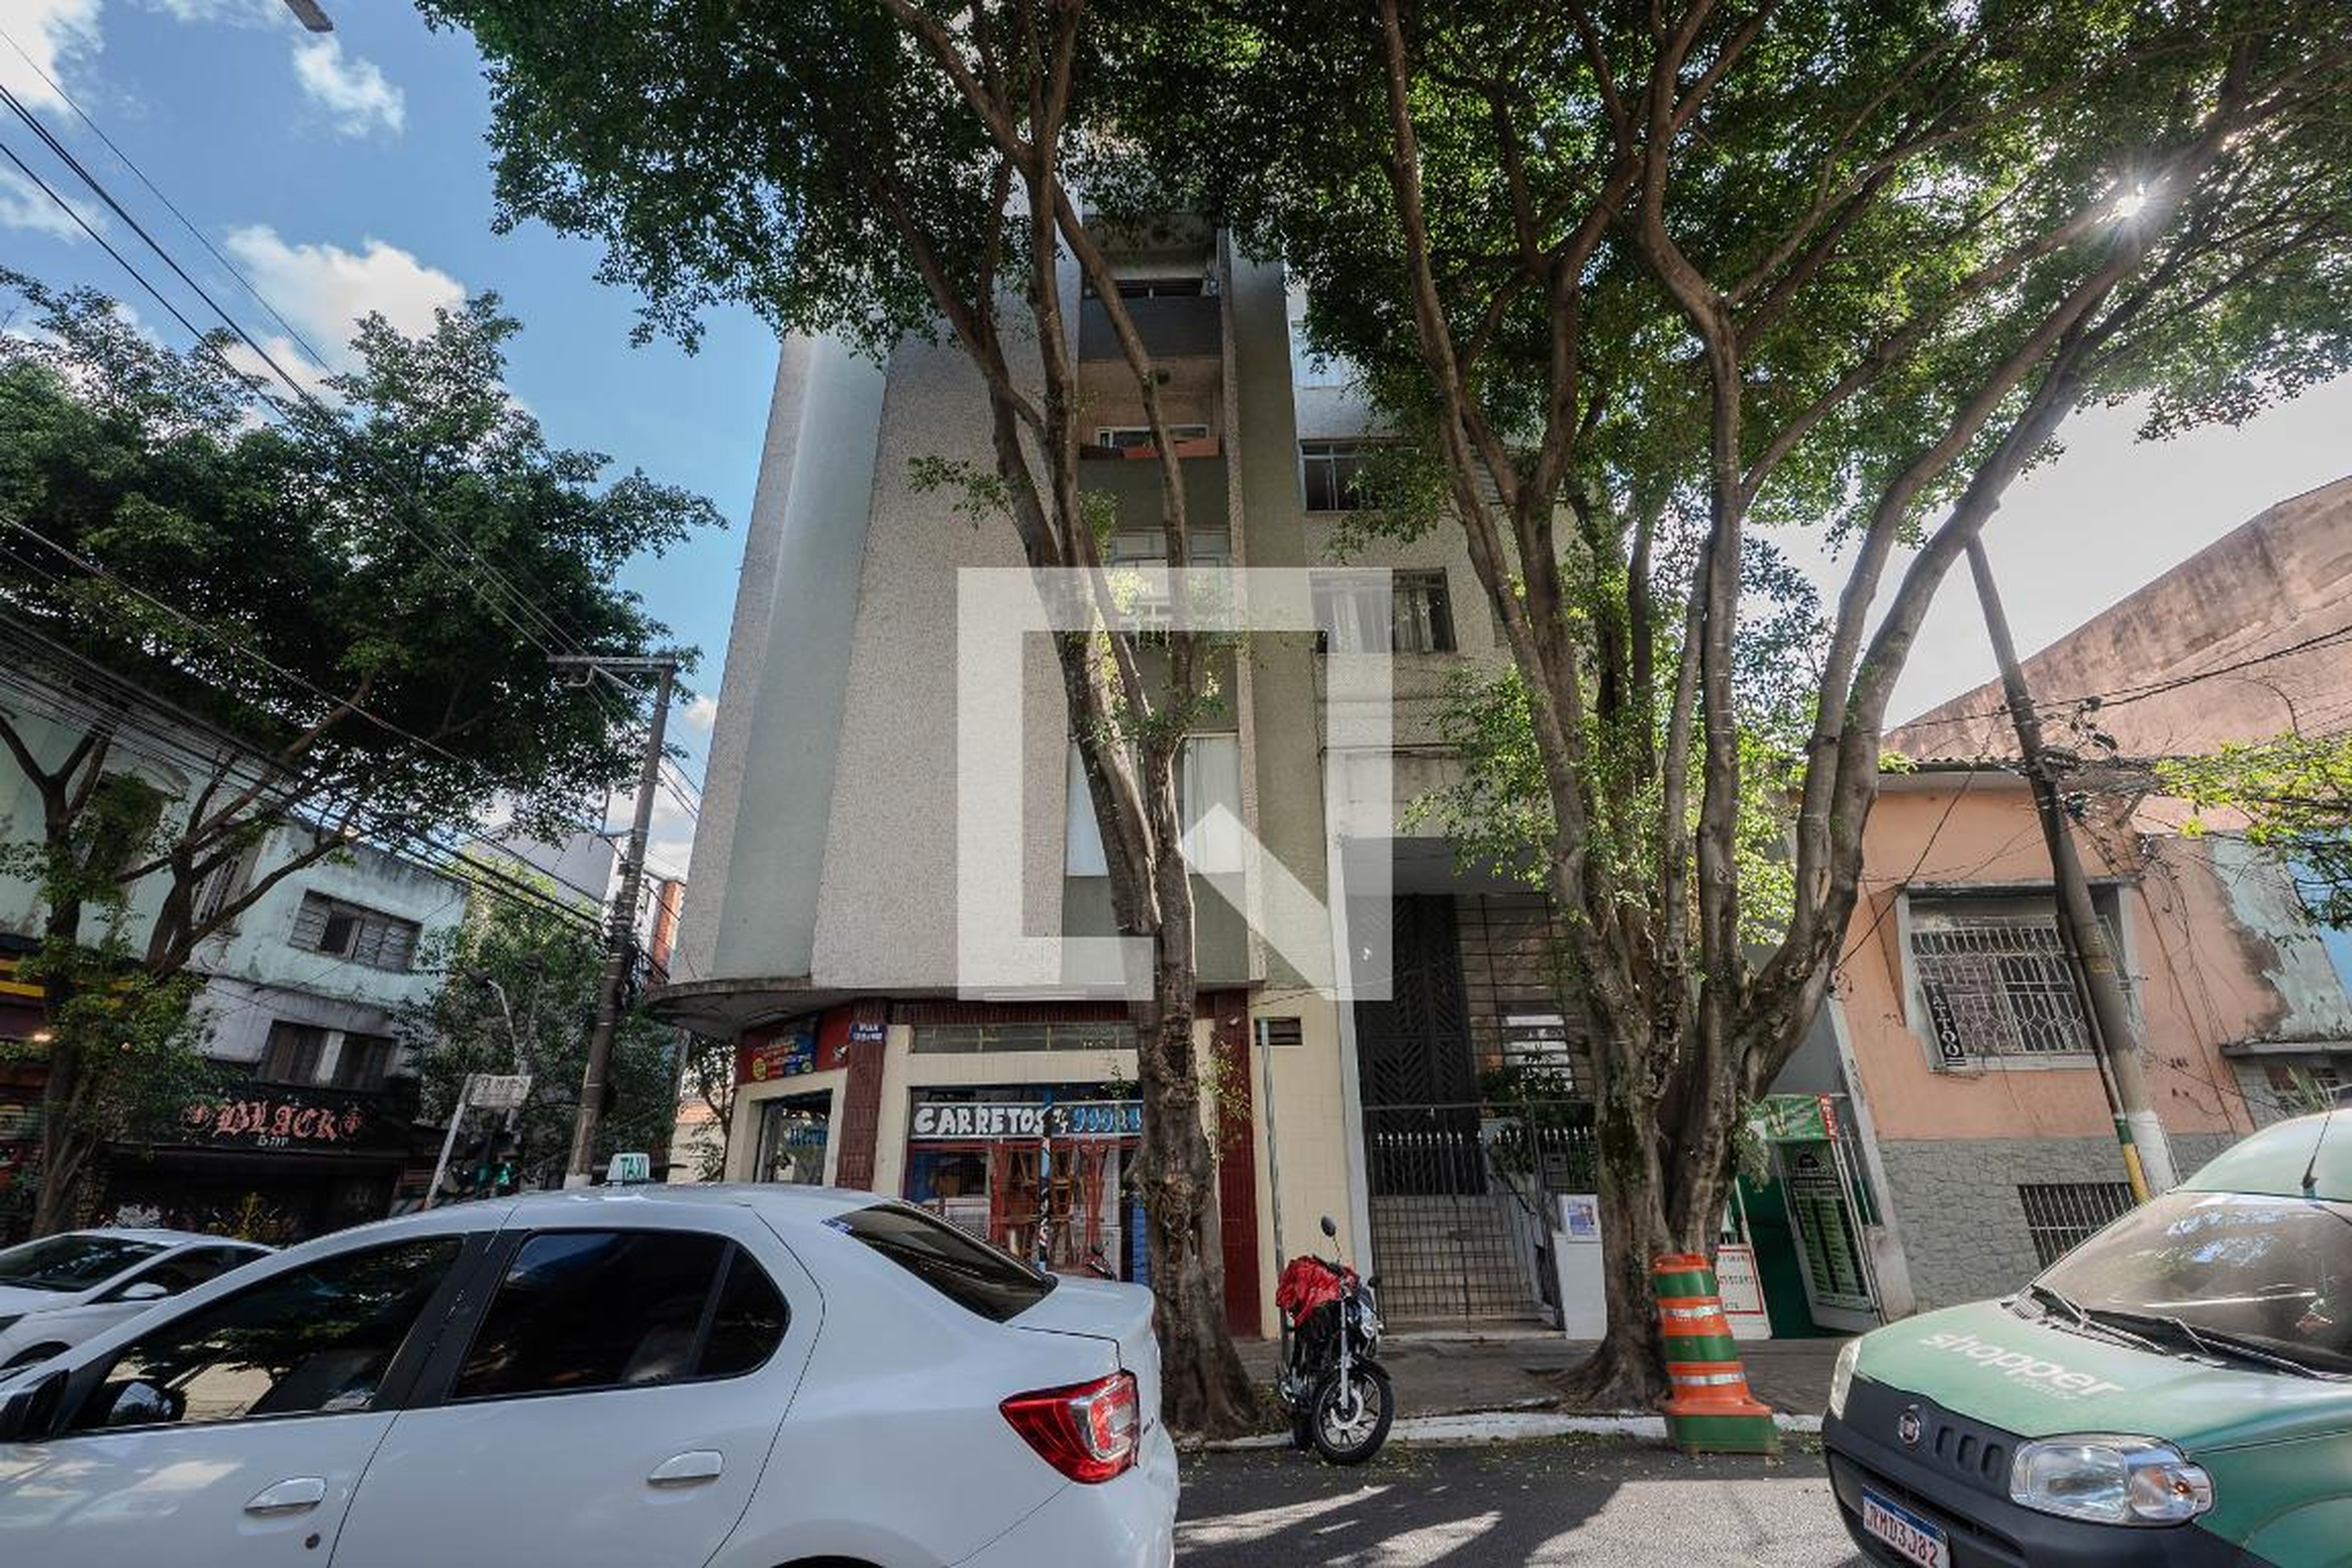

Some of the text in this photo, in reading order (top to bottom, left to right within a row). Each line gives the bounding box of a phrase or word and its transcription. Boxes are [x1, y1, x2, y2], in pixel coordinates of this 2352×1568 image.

[1926, 981, 1959, 1056] TATTOO
[212, 1100, 337, 1141] BLACK
[914, 1107, 1048, 1134] CARRETOS
[620, 1156, 648, 1178] TAXI
[1918, 1333, 2124, 1395] shopper
